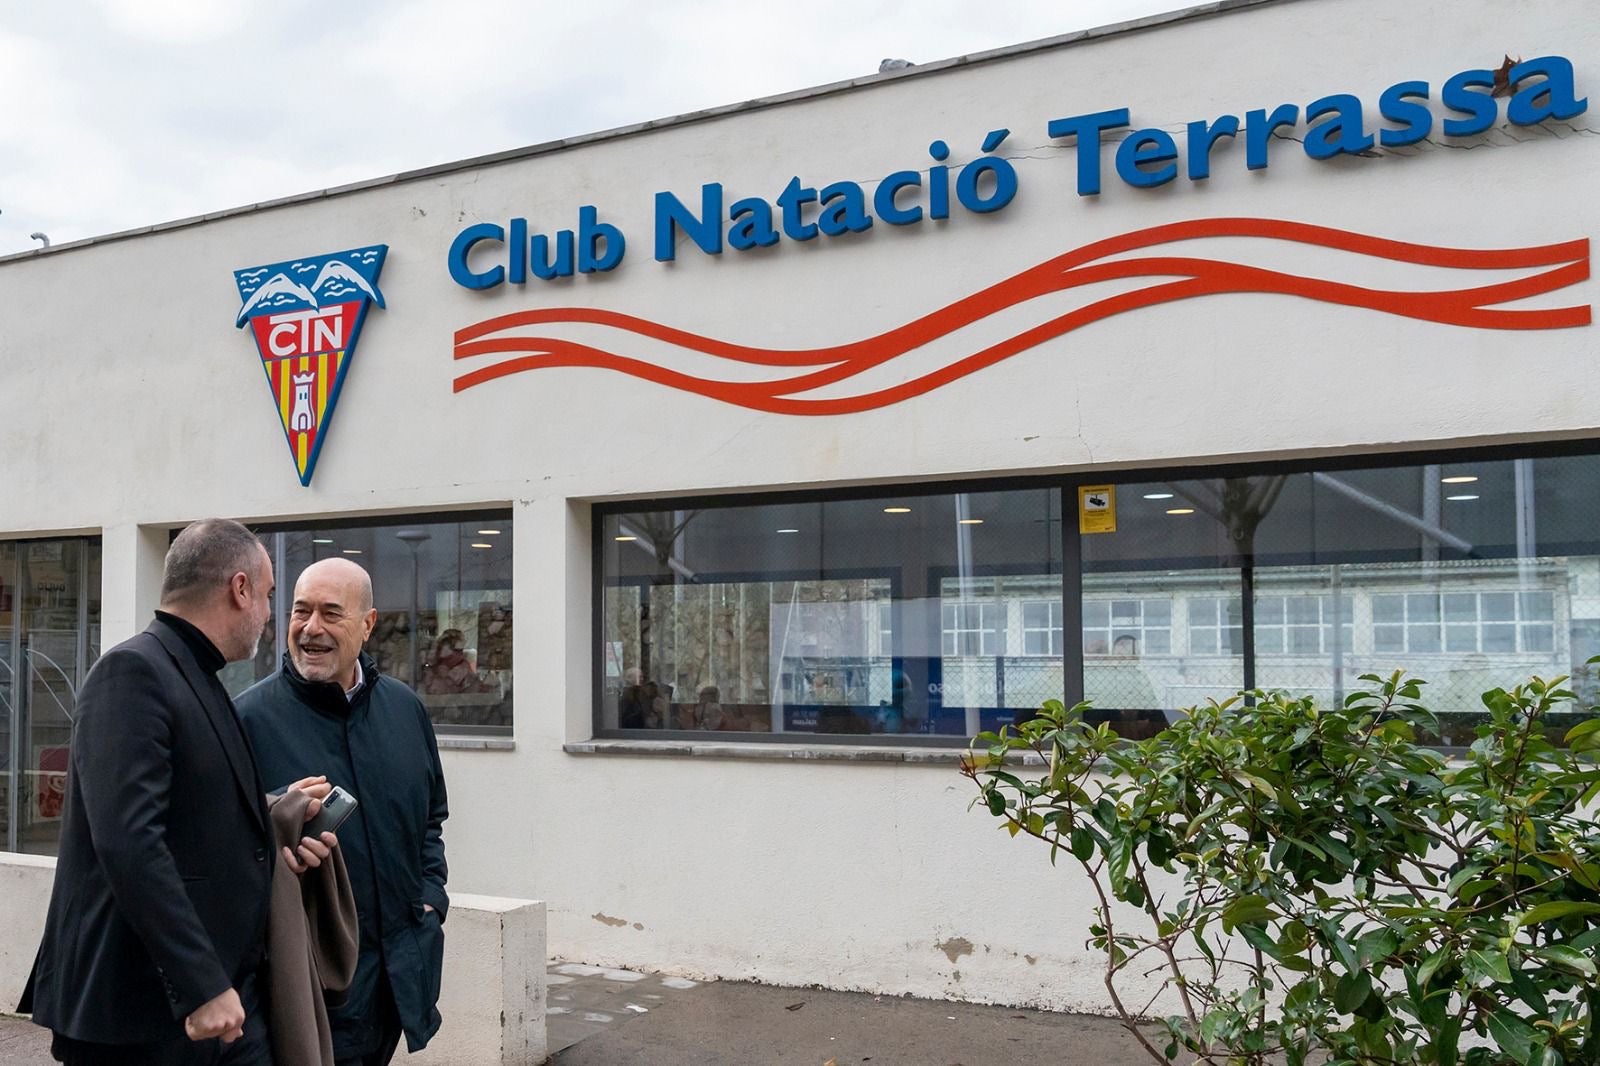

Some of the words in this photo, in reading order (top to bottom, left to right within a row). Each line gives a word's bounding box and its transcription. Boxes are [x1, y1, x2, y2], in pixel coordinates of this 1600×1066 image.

[448, 205, 626, 289] Club
[655, 128, 1018, 262] Natació
[1048, 55, 1588, 196] Terrassa
[268, 304, 343, 357] CTN
